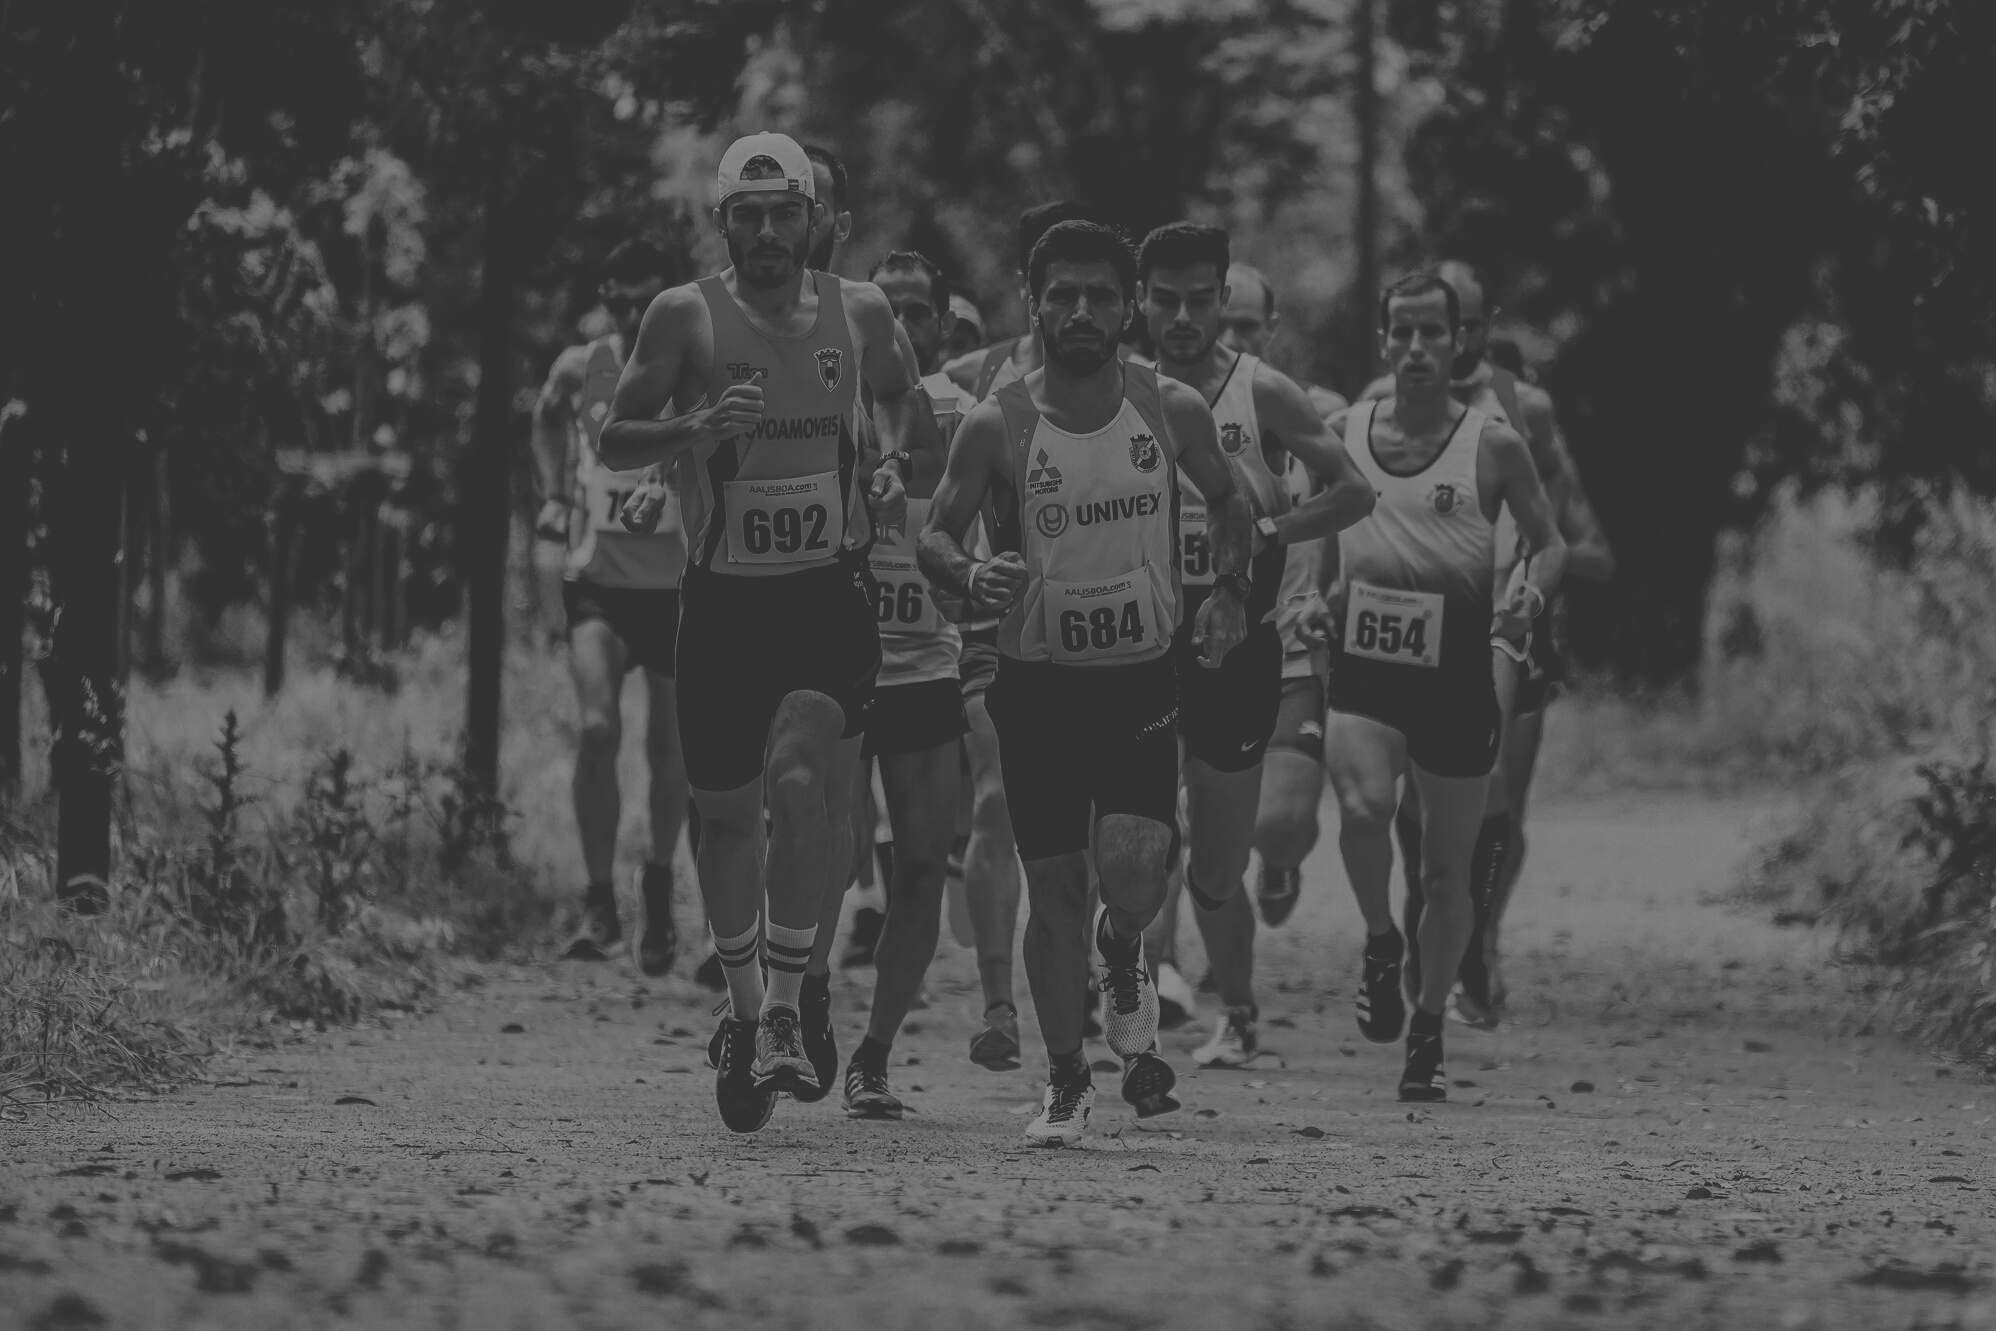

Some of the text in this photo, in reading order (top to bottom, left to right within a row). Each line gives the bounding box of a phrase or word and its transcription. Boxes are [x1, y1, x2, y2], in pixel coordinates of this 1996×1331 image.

[734, 415, 838, 440] VOAMOVEIS
[749, 483, 812, 493] AALISBOA.com
[1030, 478, 1063, 489] MITSUBISHI
[1035, 486, 1059, 495] MOTORS
[1076, 492, 1162, 526] UNIVEX
[743, 504, 828, 555] 692
[1065, 582, 1126, 596] AALISBOA.com
[1060, 599, 1144, 653] 684
[1356, 610, 1427, 657] 654
